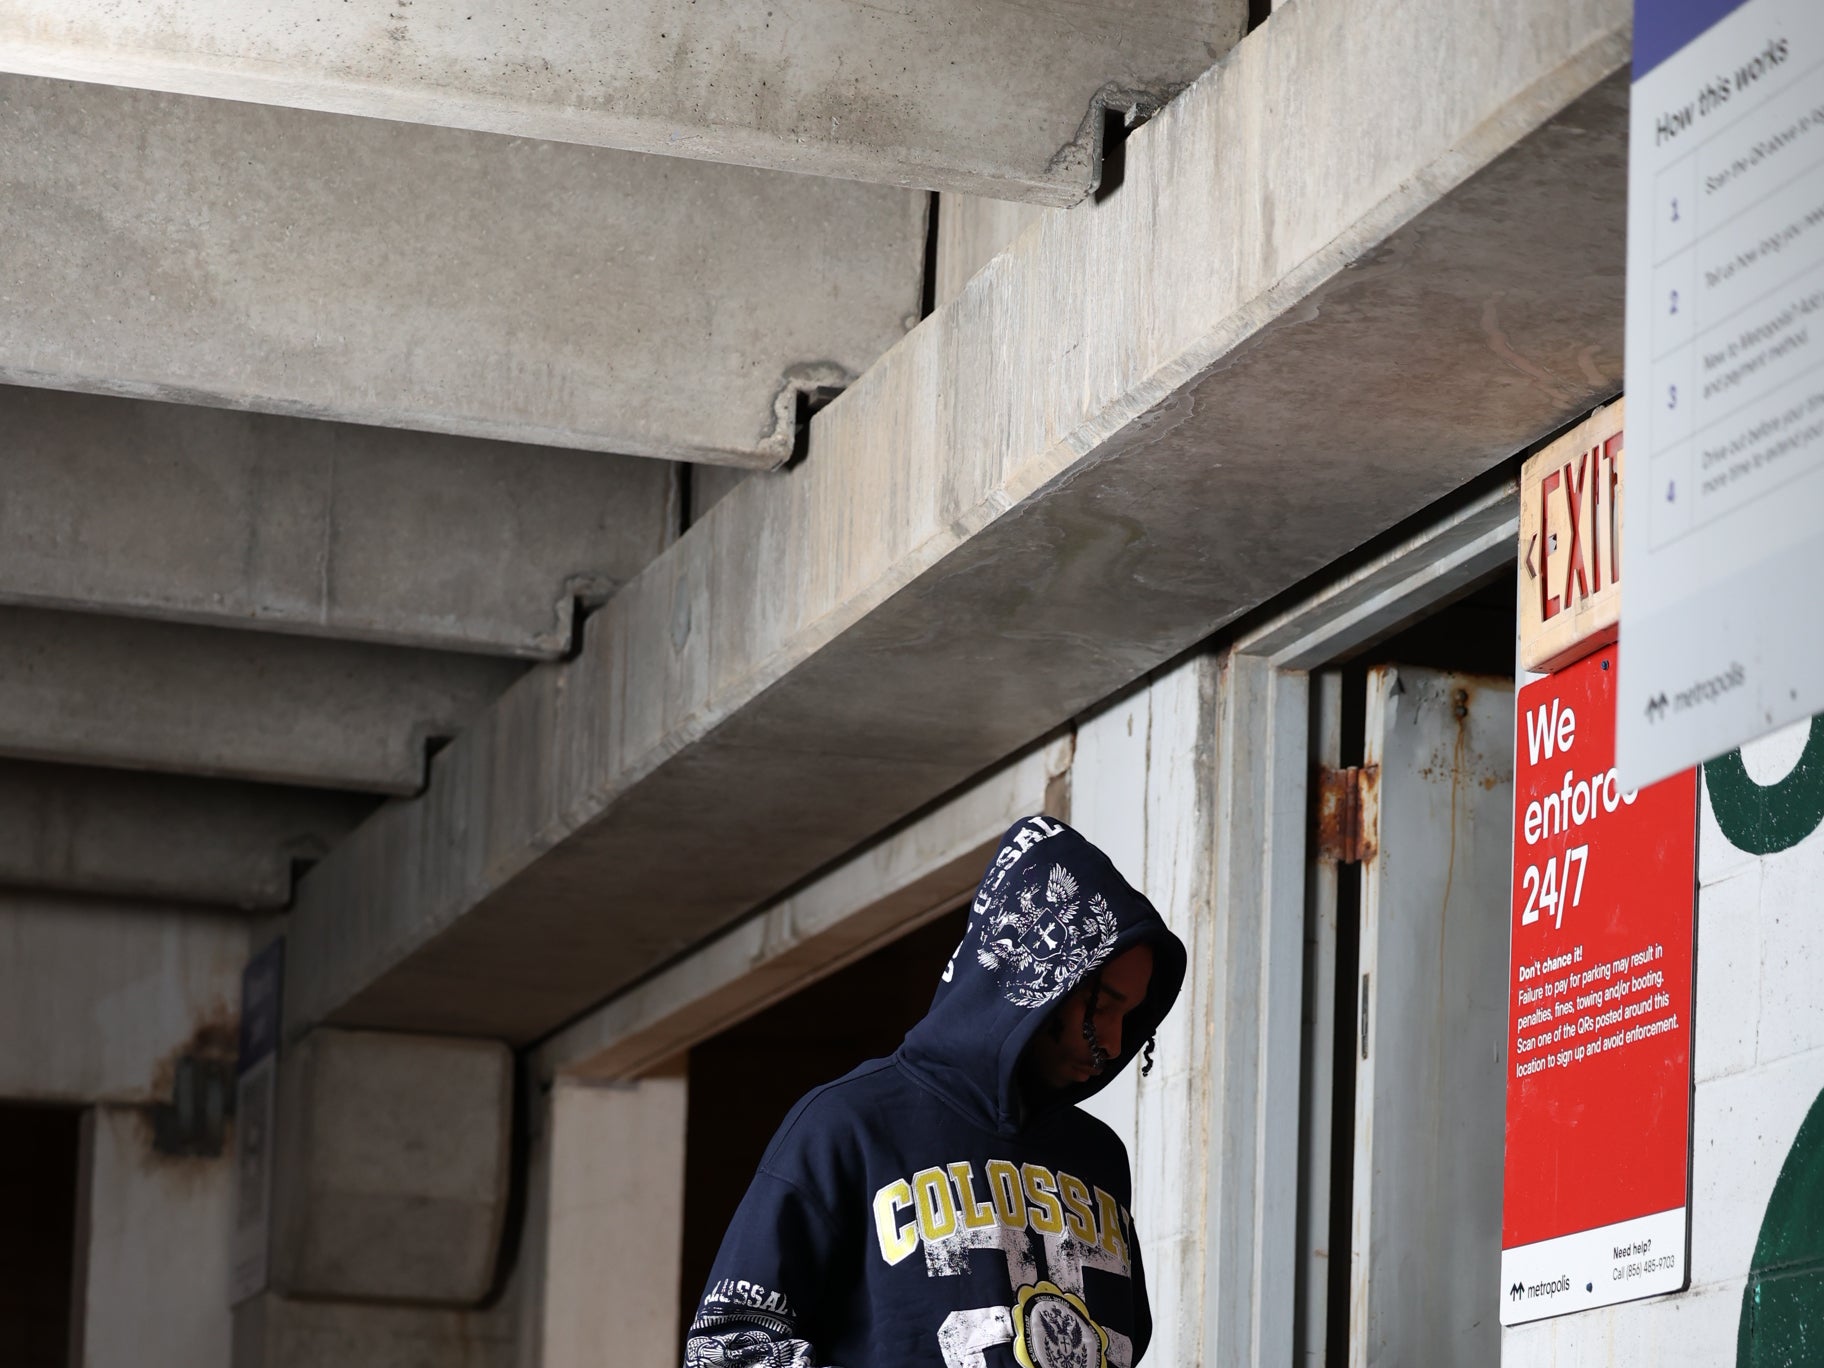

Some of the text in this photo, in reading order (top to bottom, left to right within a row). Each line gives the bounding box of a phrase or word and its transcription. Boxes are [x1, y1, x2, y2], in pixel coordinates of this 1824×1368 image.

[1656, 37, 1789, 146] How this works
[1670, 198, 1680, 222] 1
[1669, 290, 1679, 314] 2
[1667, 384, 1677, 409] 3
[1666, 480, 1675, 503] 4
[1541, 431, 1623, 623] EXIT
[1673, 661, 1746, 716] metropolis
[1526, 698, 1576, 768] We
[1521, 844, 1589, 930] 24/7
[1518, 944, 1663, 1006] Failure to pay for parking may result in
[1519, 945, 1582, 982] Don't chance it!
[1517, 993, 1669, 1054] Scan one of the QRs posted around this
[1518, 970, 1664, 1033] penalties, fines, towing and/or booting.
[1516, 1014, 1679, 1078] location to sign up and avoid enforcement.
[872, 1159, 1131, 1267] COLOSSA
[1613, 1239, 1651, 1259] Need help?
[1613, 1255, 1675, 1281] Call (856) 485-9703
[1527, 1275, 1570, 1299] metropolis
